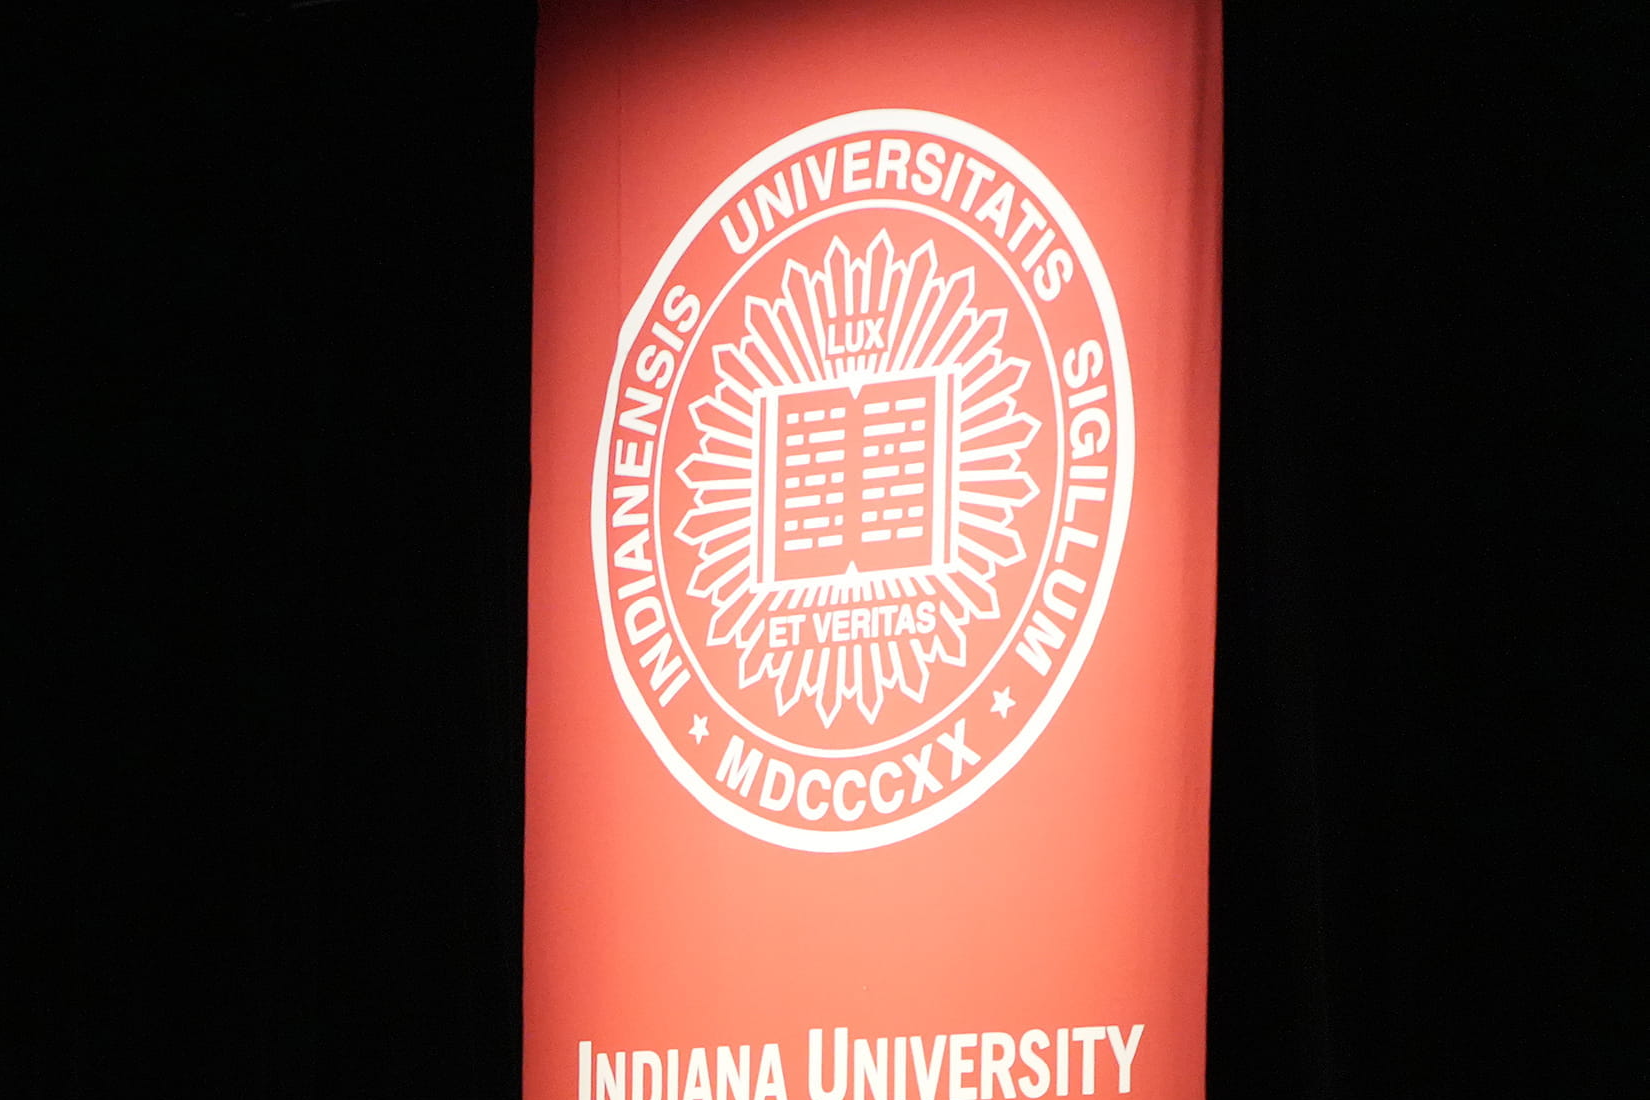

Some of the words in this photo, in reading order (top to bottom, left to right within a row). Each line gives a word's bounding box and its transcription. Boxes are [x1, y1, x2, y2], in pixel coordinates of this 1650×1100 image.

[721, 139, 1073, 301] UNIVERSITATIS
[827, 317, 885, 356] LUX
[613, 286, 701, 707] INDIANENSIS
[1015, 340, 1110, 677] SIGILLUM
[769, 612, 809, 648] ET
[812, 601, 937, 644] VERITAS
[716, 719, 981, 822] MDCCCXX
